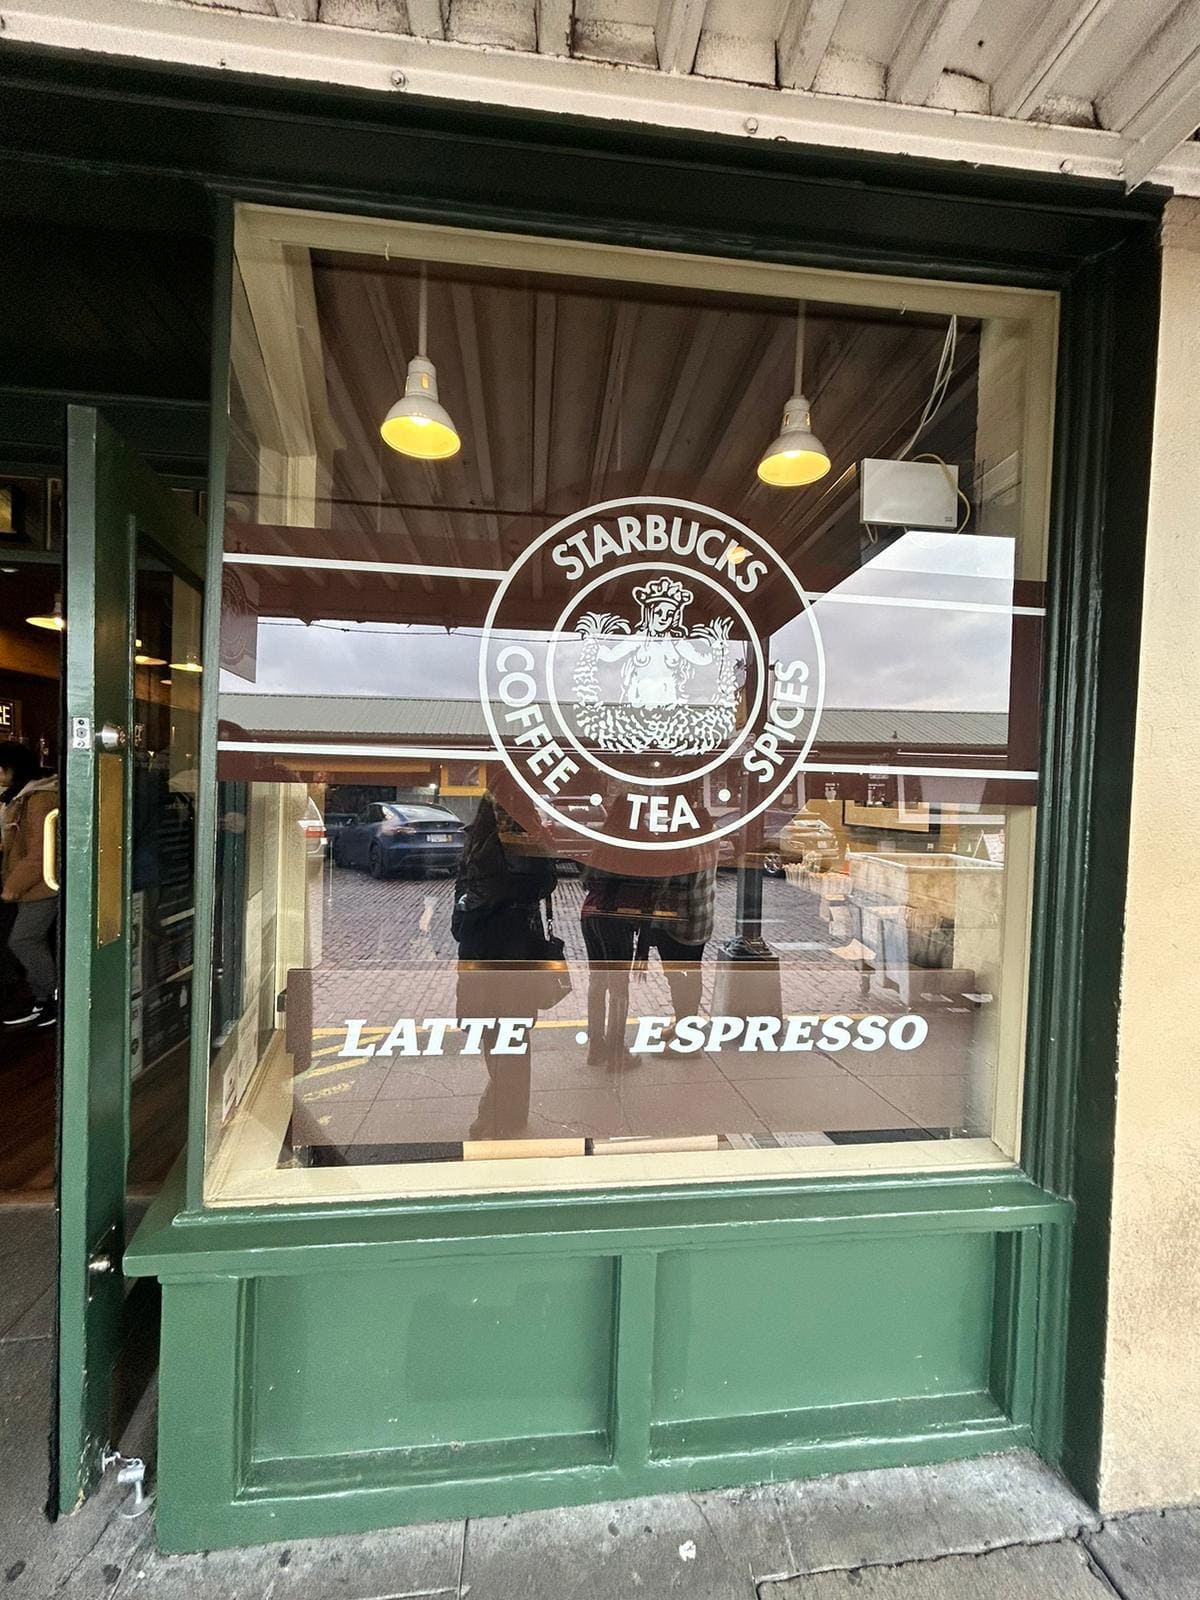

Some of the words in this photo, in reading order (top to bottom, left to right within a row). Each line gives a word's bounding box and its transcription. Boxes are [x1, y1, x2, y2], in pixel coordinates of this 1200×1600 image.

[551, 514, 768, 593] STARBUCKS
[496, 645, 580, 795] COFFEE
[626, 793, 700, 833] TEA
[743, 660, 809, 783] SPICES
[338, 1017, 537, 1057] LATTE
[628, 1014, 930, 1054] ESPRESSO
